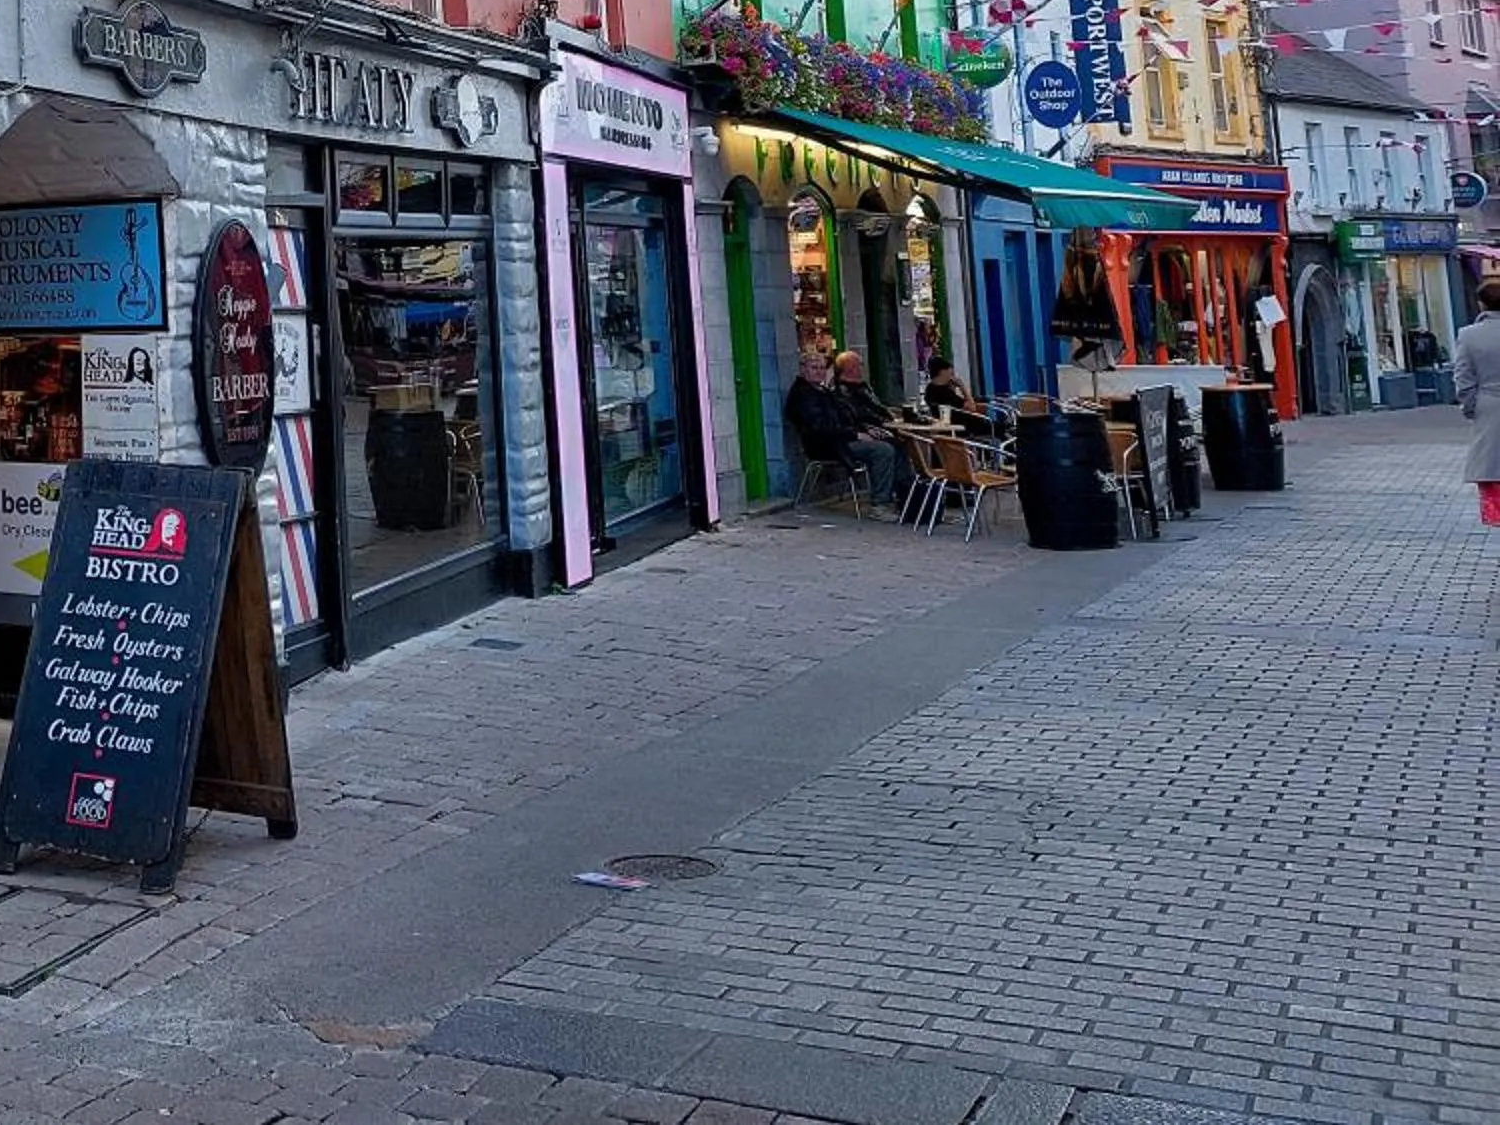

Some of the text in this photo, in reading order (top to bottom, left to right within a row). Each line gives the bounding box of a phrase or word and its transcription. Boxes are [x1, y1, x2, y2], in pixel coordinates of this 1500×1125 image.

[104, 25, 189, 66] BARBERS
[1029, 88, 1076, 100] Outdoor
[1041, 76, 1063, 88] The
[1038, 101, 1069, 112] Shop
[212, 374, 270, 402] BARBER
[91, 530, 146, 550] HEAD
[86, 557, 179, 586] BISTRO
[61, 592, 130, 620] Lobster
[141, 602, 191, 632] Chips
[53, 625, 184, 661] Fresh Oysters
[45, 658, 183, 694] Galway Hooker
[56, 686, 97, 710] Fish
[109, 693, 161, 723] Chips
[48, 718, 154, 753] Crab Claws
